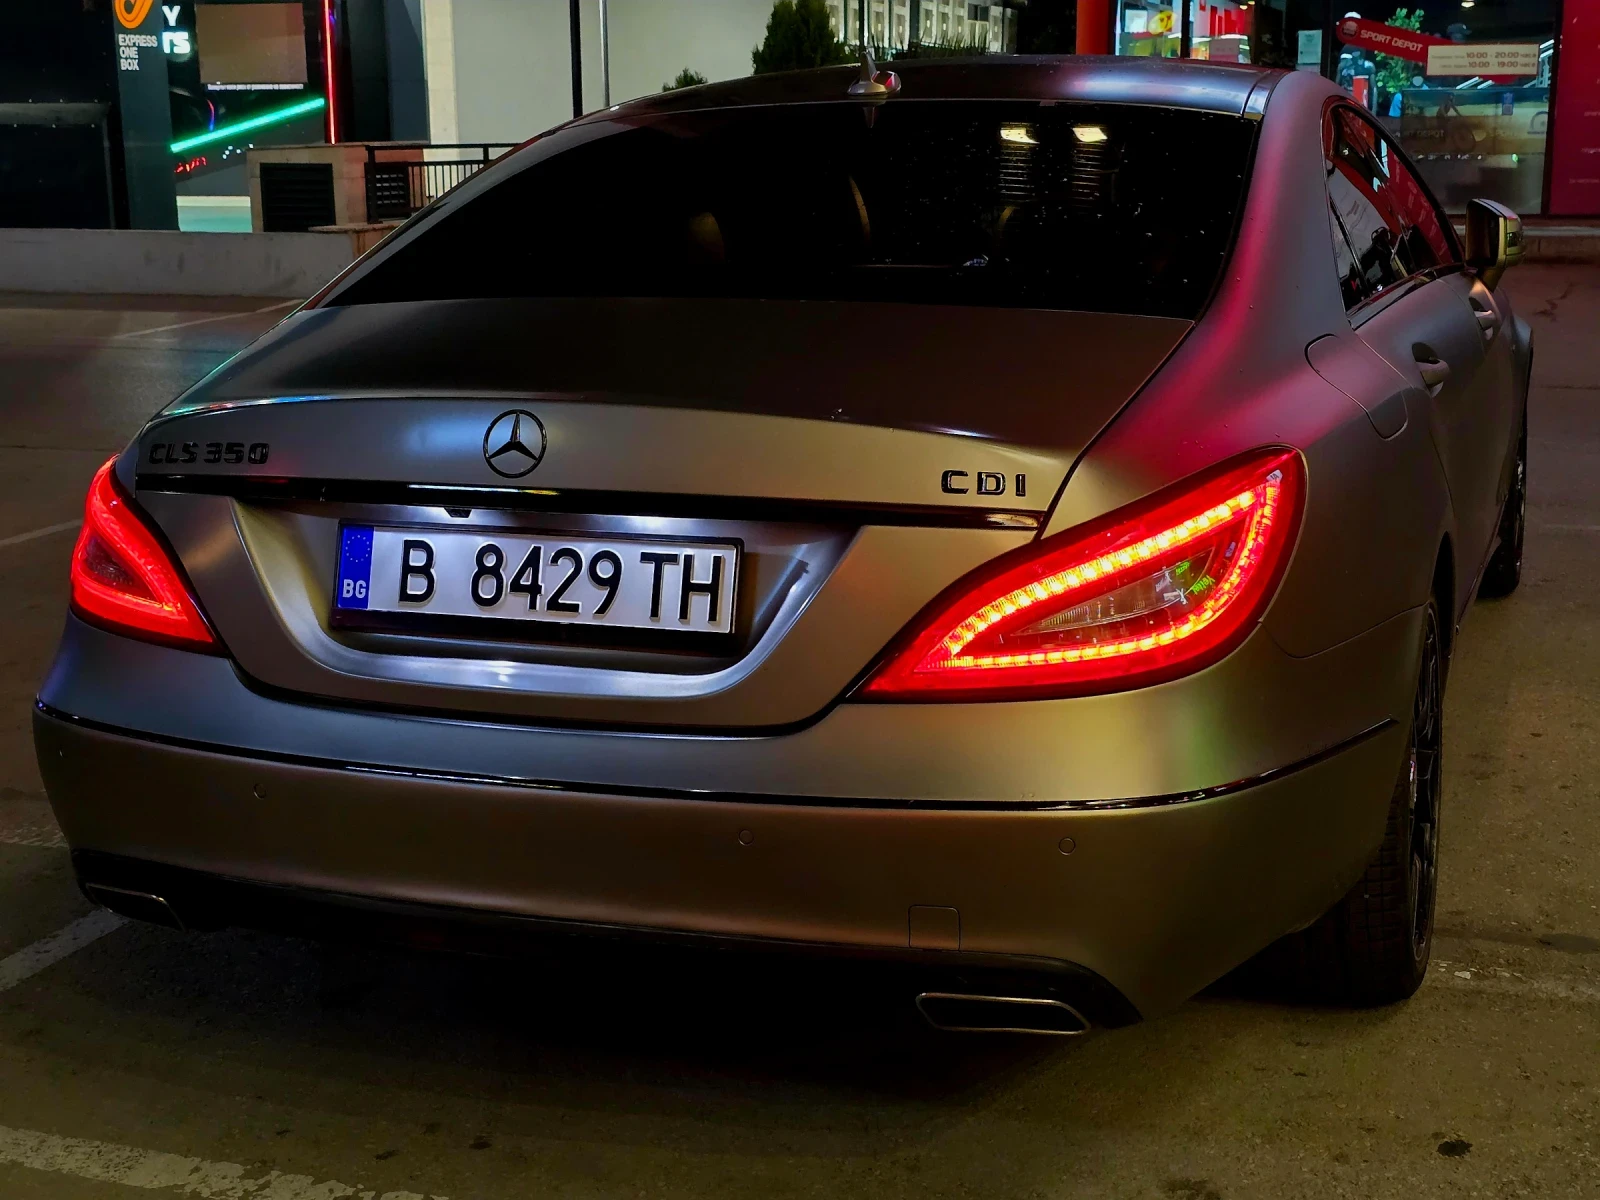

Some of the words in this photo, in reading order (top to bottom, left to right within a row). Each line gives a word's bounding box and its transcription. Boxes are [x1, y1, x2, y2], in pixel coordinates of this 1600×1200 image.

[118, 33, 158, 47] EXPRESS
[1360, 29, 1392, 44] SPORT
[1391, 37, 1424, 53] DEPOT
[119, 46, 139, 59] ONE
[120, 58, 140, 71] BOX
[148, 442, 199, 465] CLS
[203, 442, 270, 465] 350
[941, 469, 1027, 497] CDI
[342, 579, 367, 598] BG
[399, 539, 436, 604] B
[470, 543, 624, 618] 8429
[639, 551, 725, 624] TH
